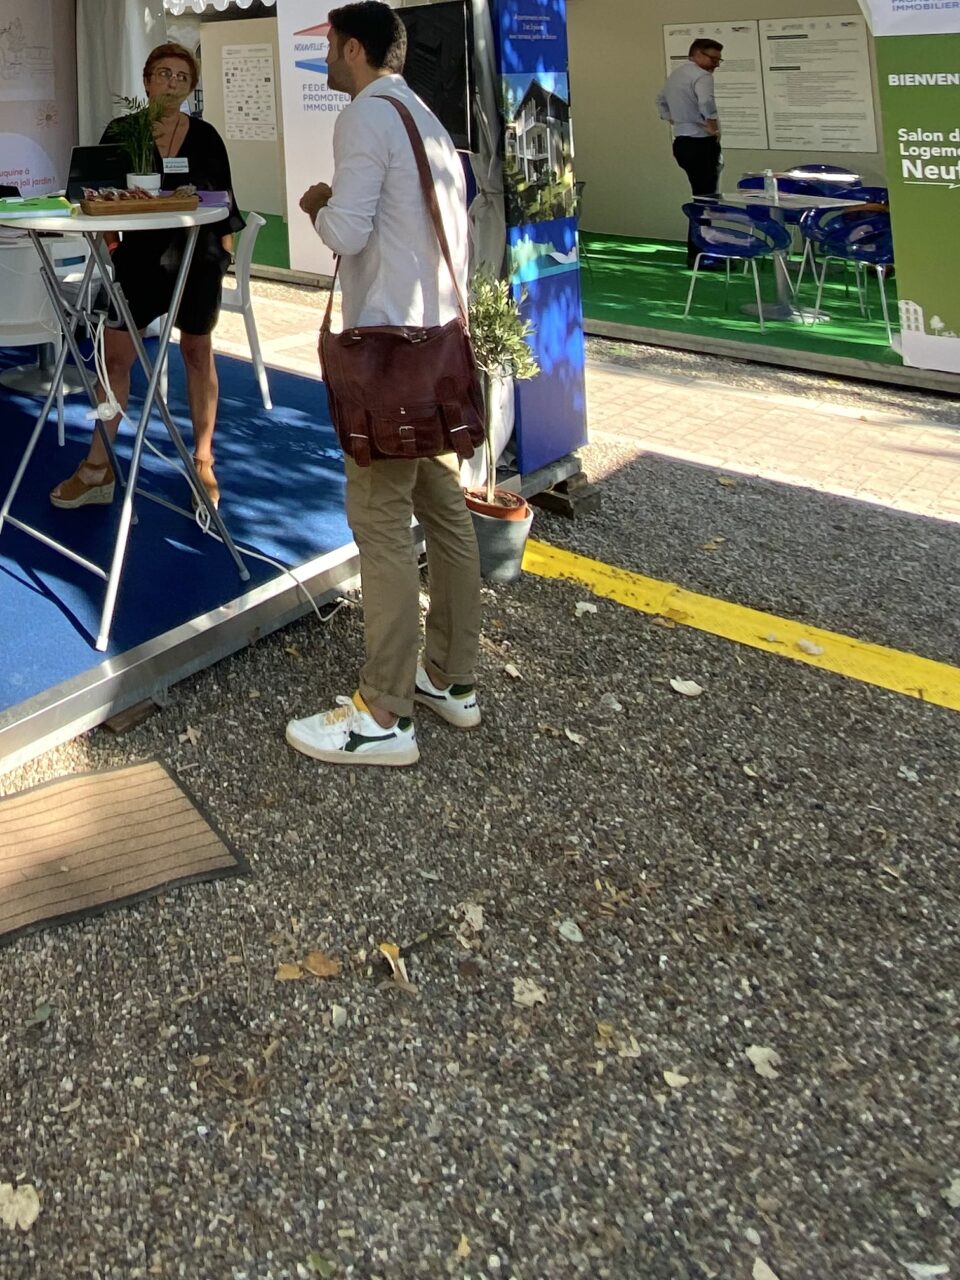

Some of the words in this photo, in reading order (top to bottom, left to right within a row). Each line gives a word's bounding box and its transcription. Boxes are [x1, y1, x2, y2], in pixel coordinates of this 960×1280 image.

[294, 42, 329, 52] NOUVELLE-
[303, 93, 351, 102] PROMOTEU
[303, 103, 348, 112] IMMOBILI
[898, 128, 944, 142] Salon
